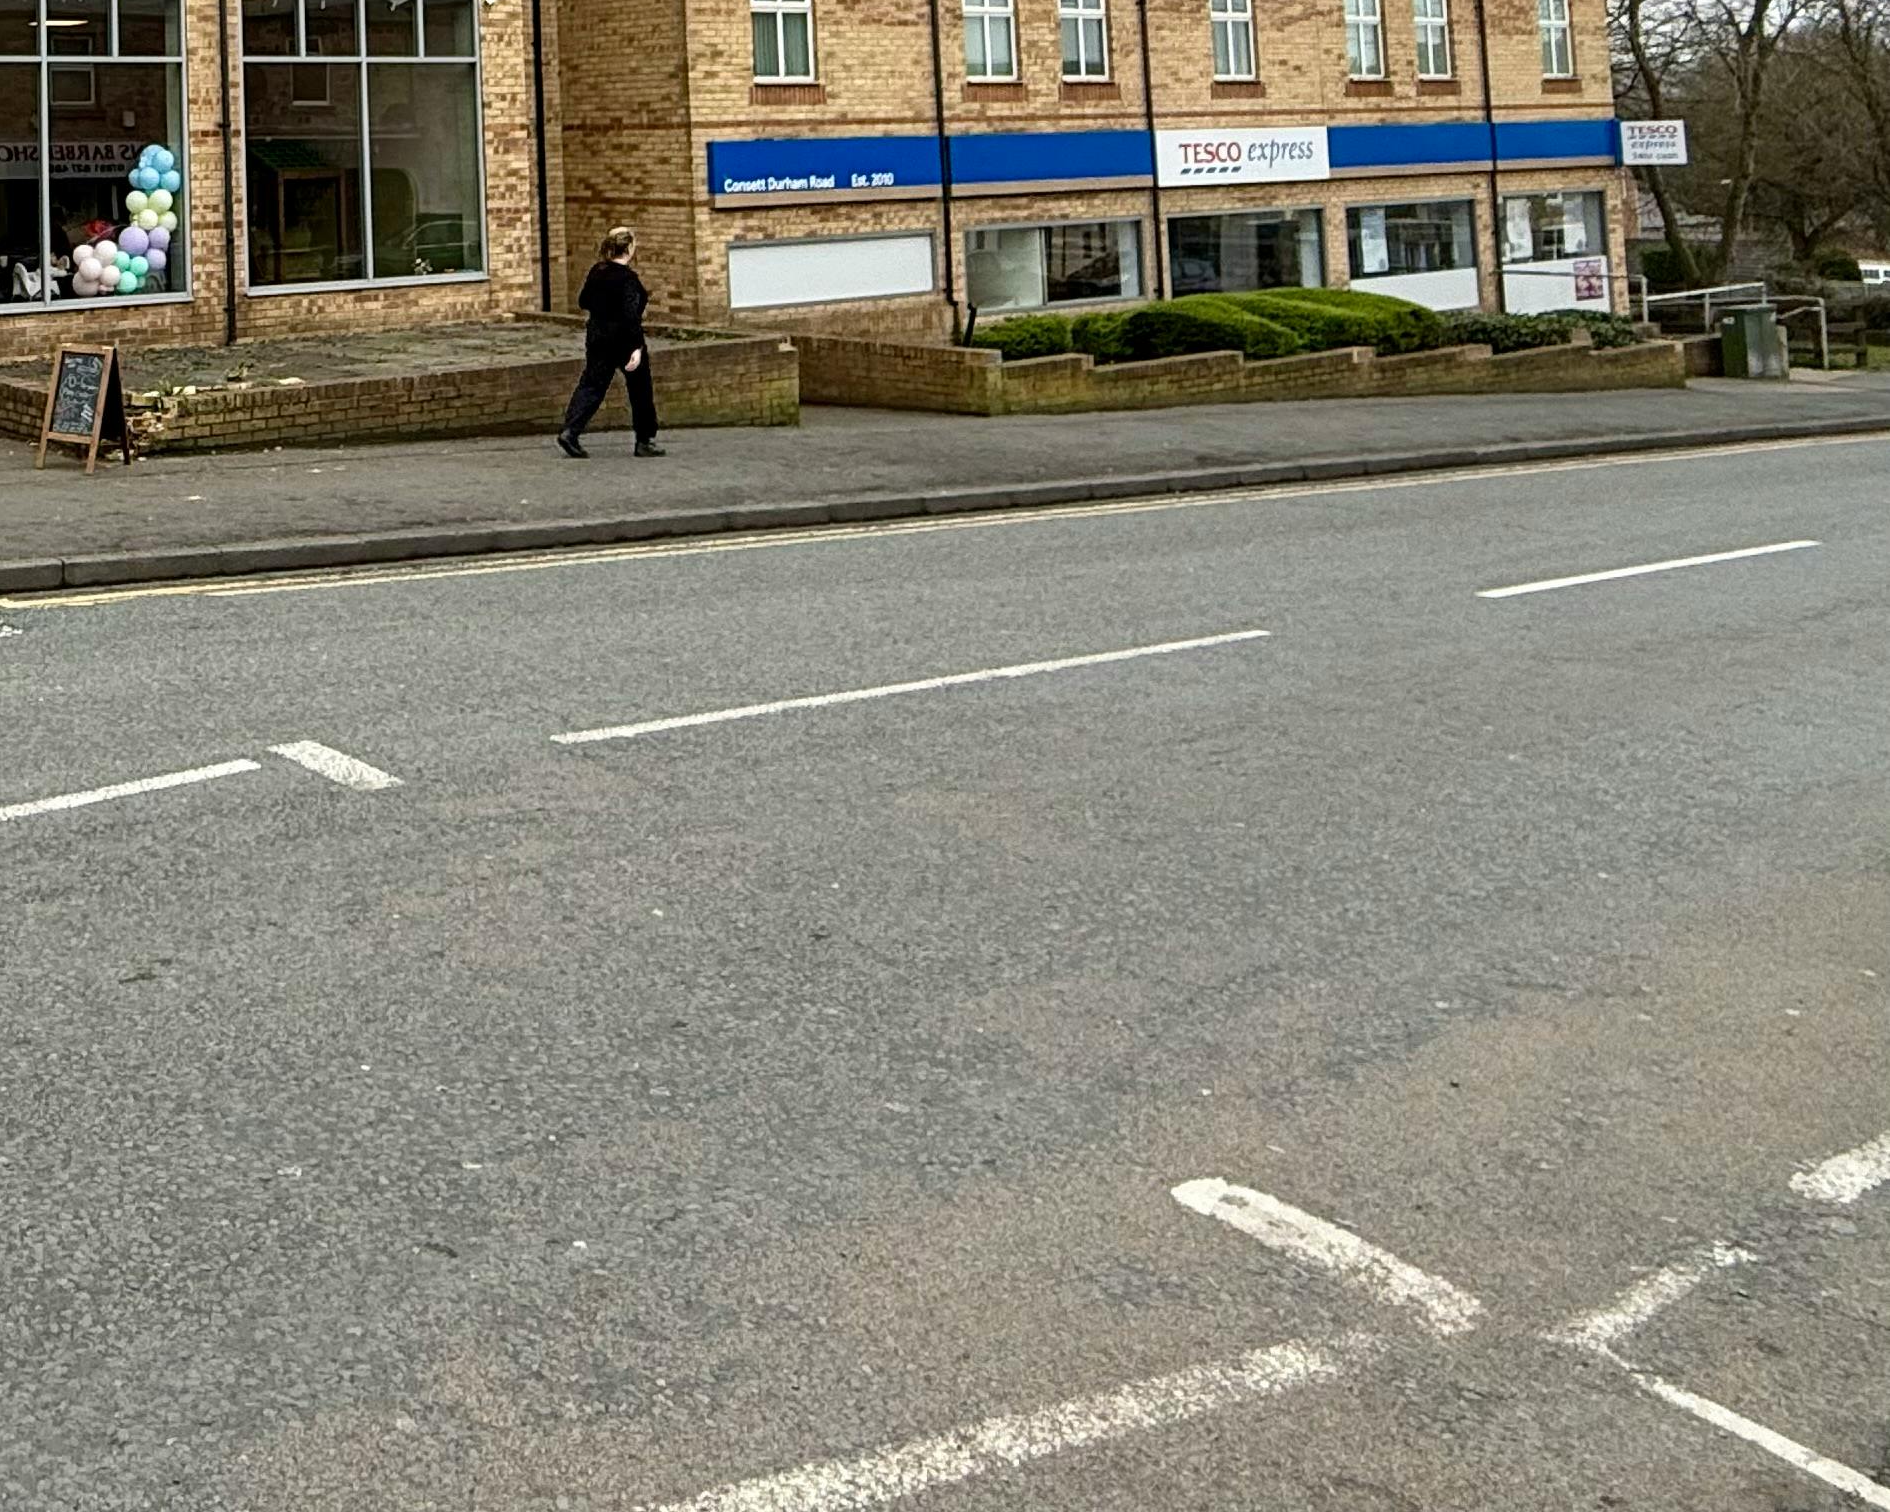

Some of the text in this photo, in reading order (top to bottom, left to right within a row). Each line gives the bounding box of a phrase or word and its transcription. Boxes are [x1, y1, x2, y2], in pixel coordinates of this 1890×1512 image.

[1627, 125, 1678, 135] TESCO
[1178, 138, 1314, 169] TESCO express
[724, 178, 767, 193] Consett
[768, 176, 808, 191] Durham
[809, 174, 835, 189] Road
[851, 173, 870, 188] Est.
